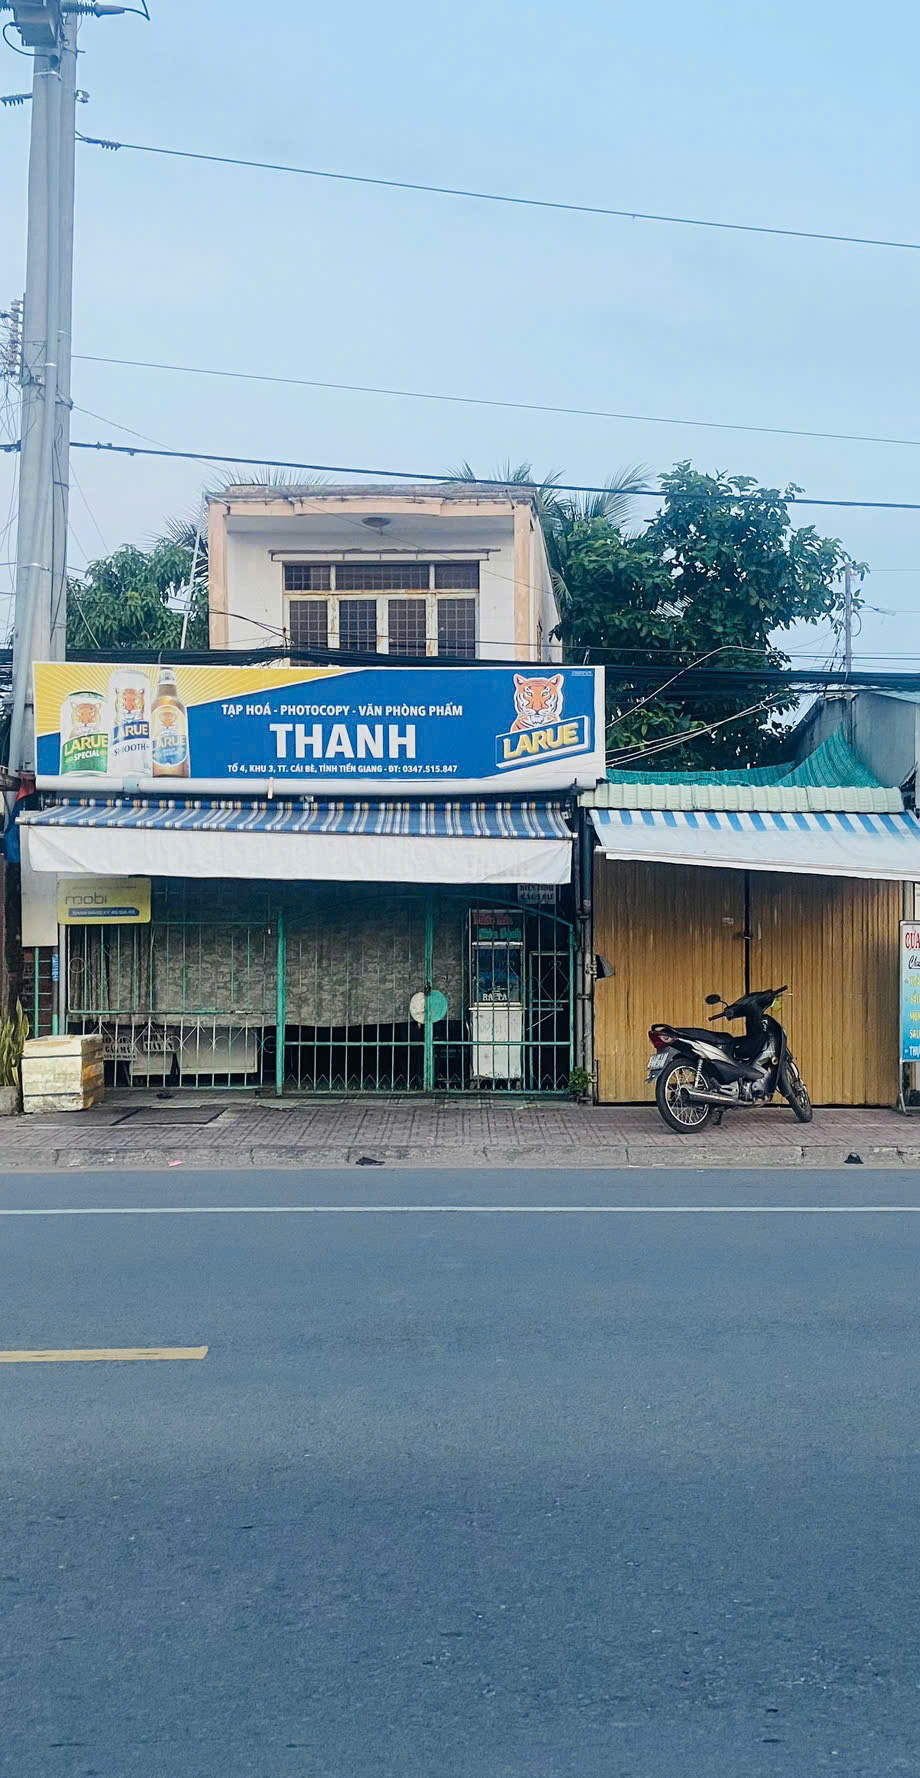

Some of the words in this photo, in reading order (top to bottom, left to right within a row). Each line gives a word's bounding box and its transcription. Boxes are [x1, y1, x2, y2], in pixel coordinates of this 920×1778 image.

[221, 704, 244, 718] TẠP
[245, 702, 272, 716] HOÁ
[280, 704, 350, 717] PHOTOCOPY
[358, 703, 383, 717] VĂN
[385, 703, 426, 717] PHÒNG
[428, 701, 463, 717] PHẨM
[64, 735, 109, 758] LARUE
[113, 742, 146, 757] SOOTH
[269, 723, 417, 759] THANH
[503, 722, 579, 760] LARUE
[73, 750, 100, 762] SPECIAL
[227, 762, 239, 773] TỔ
[239, 764, 248, 774] 4,
[249, 764, 267, 773] KHU
[268, 764, 276, 774] 3,
[277, 764, 289, 773] TT.
[290, 762, 304, 773] CÁI
[304, 762, 318, 774] BÈ,
[357, 764, 383, 773] GIANG
[388, 764, 401, 773] ĐT:
[402, 764, 458, 774] 0347.515.847
